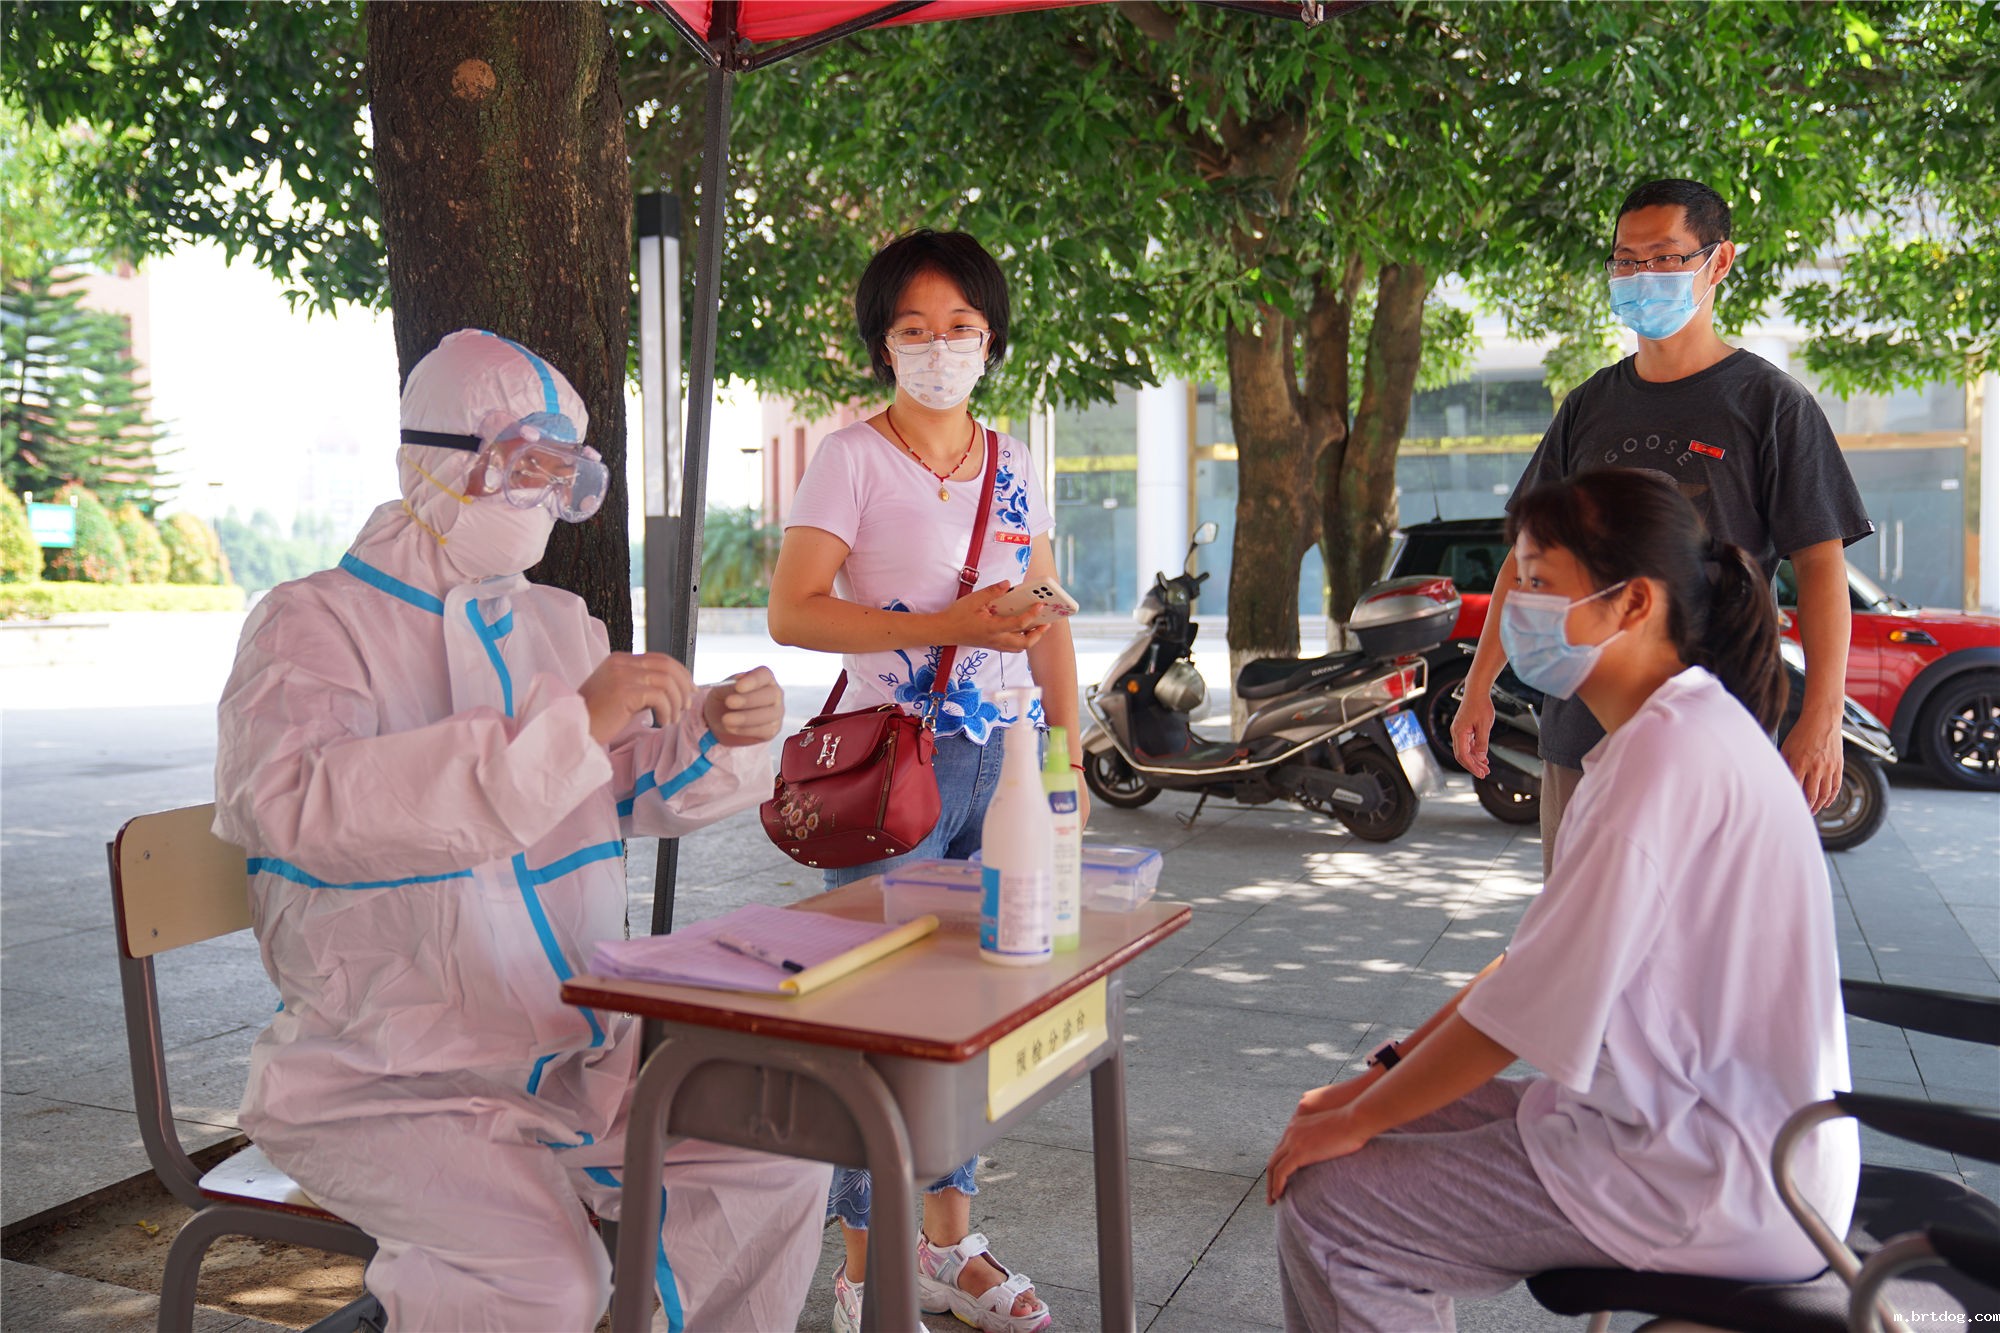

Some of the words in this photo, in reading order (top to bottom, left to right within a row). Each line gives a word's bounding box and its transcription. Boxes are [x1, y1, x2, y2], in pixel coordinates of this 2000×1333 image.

[1604, 434, 1693, 467] GOOSE
[1016, 1009, 1085, 1077] 预检分诊台
